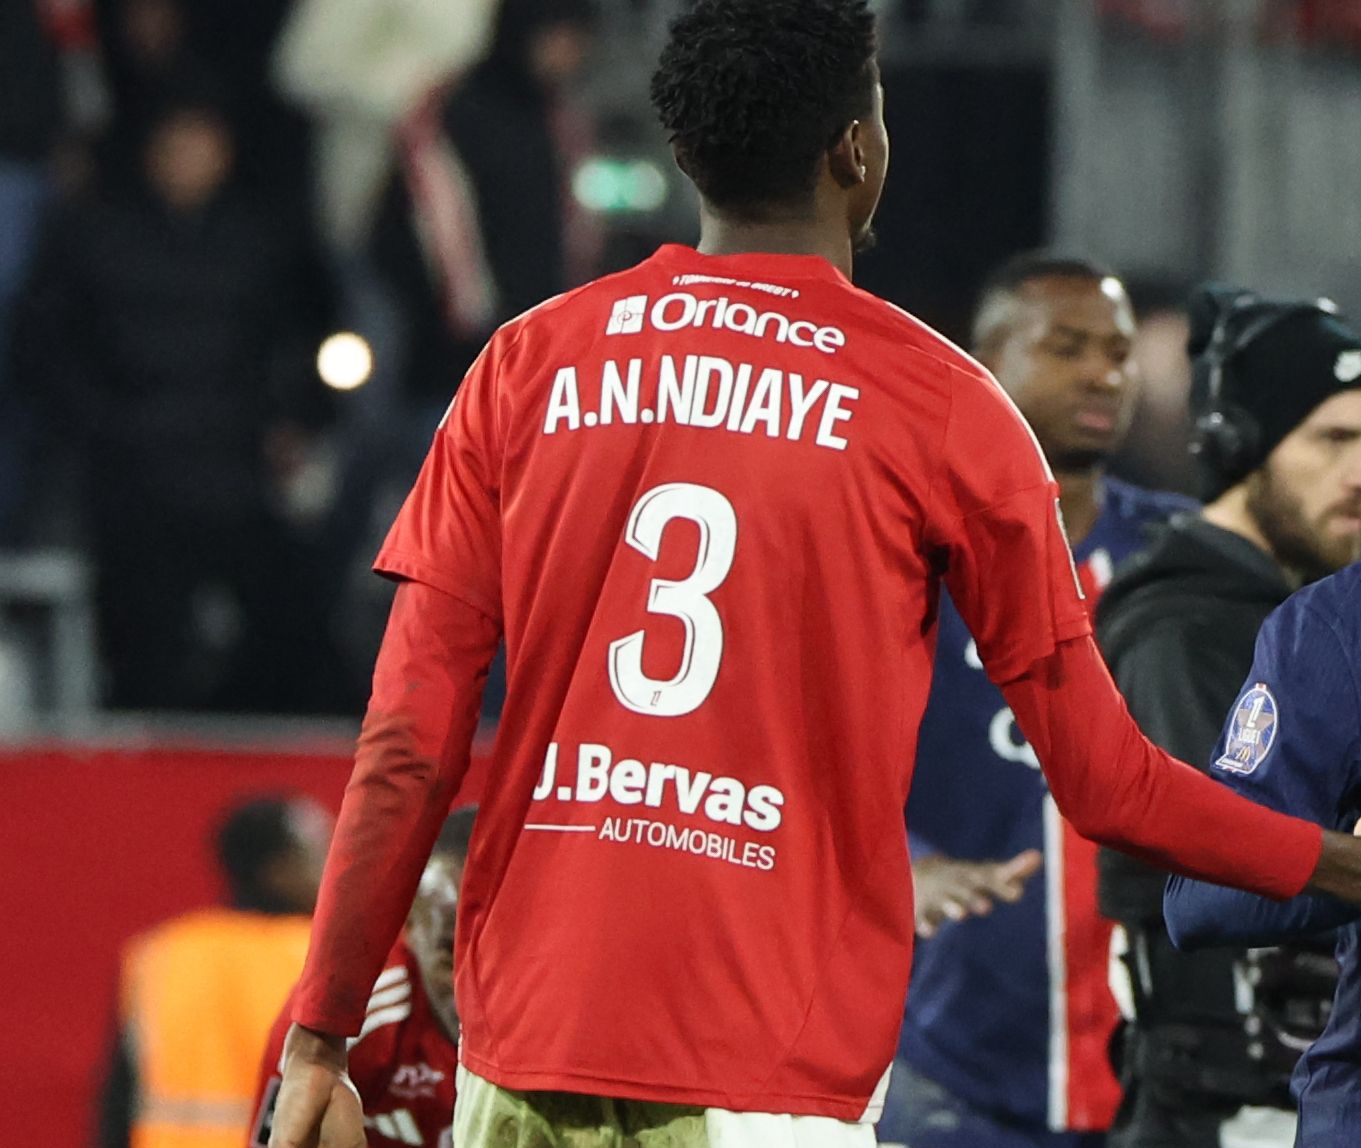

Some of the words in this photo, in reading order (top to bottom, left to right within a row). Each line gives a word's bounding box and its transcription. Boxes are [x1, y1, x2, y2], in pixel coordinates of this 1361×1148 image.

[650, 293, 845, 353] Oriance
[543, 354, 859, 450] A.N.NDIAYE
[607, 482, 738, 717] 3
[532, 742, 785, 831] J.Bervas
[598, 817, 776, 870] AUTOMOBILES
